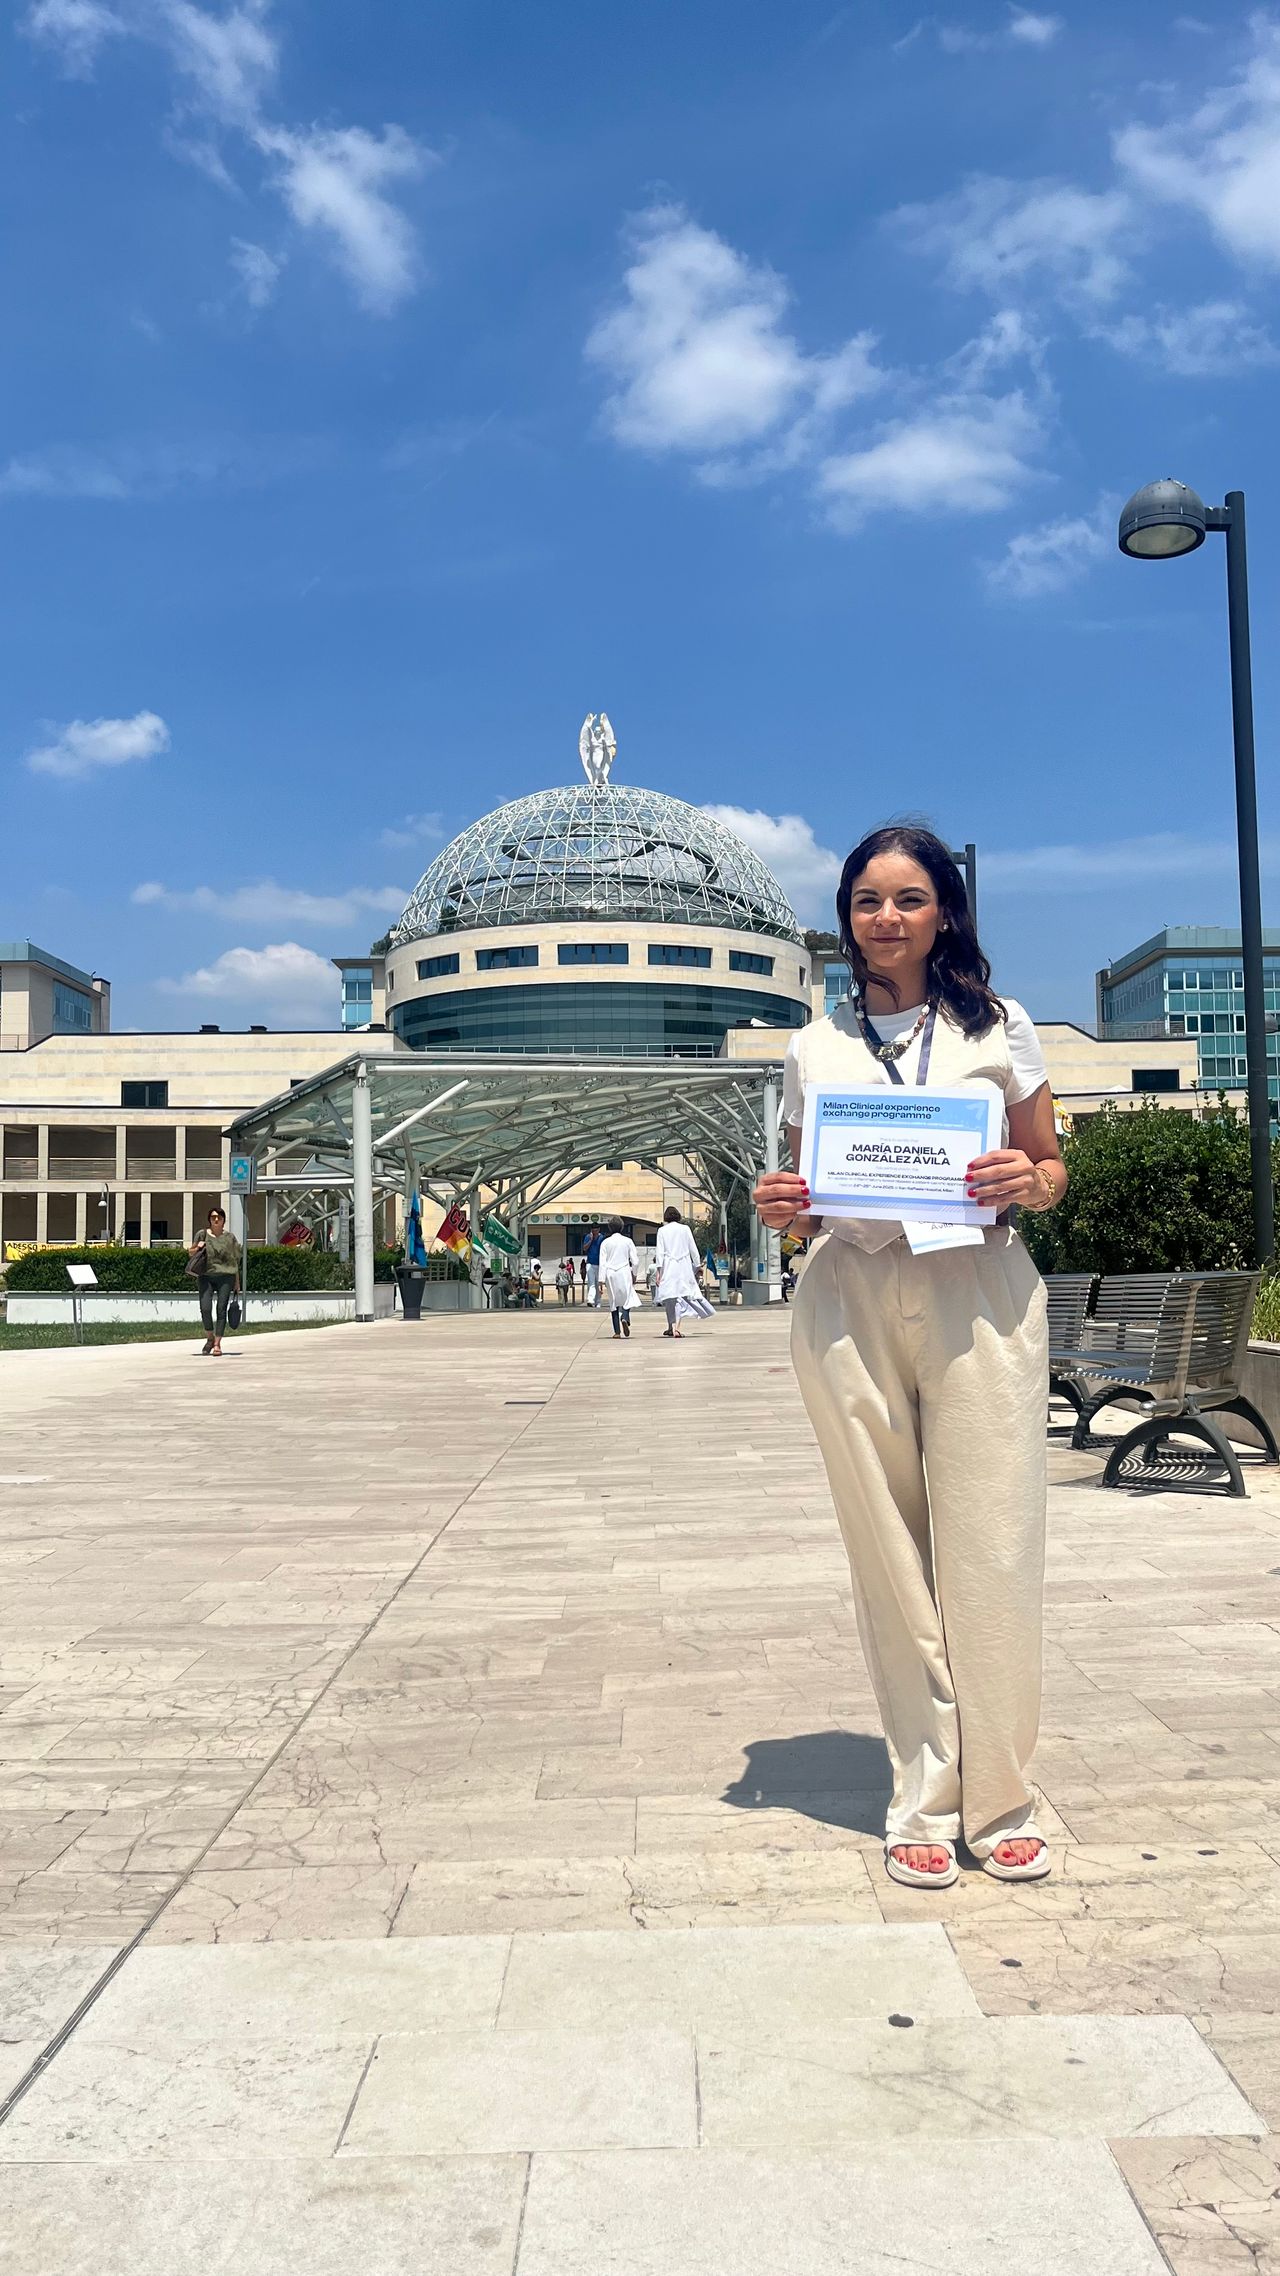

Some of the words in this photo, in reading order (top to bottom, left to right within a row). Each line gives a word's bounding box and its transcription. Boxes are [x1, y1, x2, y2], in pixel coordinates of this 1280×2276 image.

[823, 1102, 848, 1110] Milan
[849, 1102, 883, 1111] Clinical
[884, 1103, 941, 1113] experience
[822, 1110, 870, 1118] exchange
[871, 1111, 932, 1120] programme
[852, 1142, 892, 1154] MARÍA
[893, 1145, 947, 1156] DANIELA
[845, 1152, 911, 1164] GONZÁLEZ
[912, 1153, 951, 1166] ÁVILA
